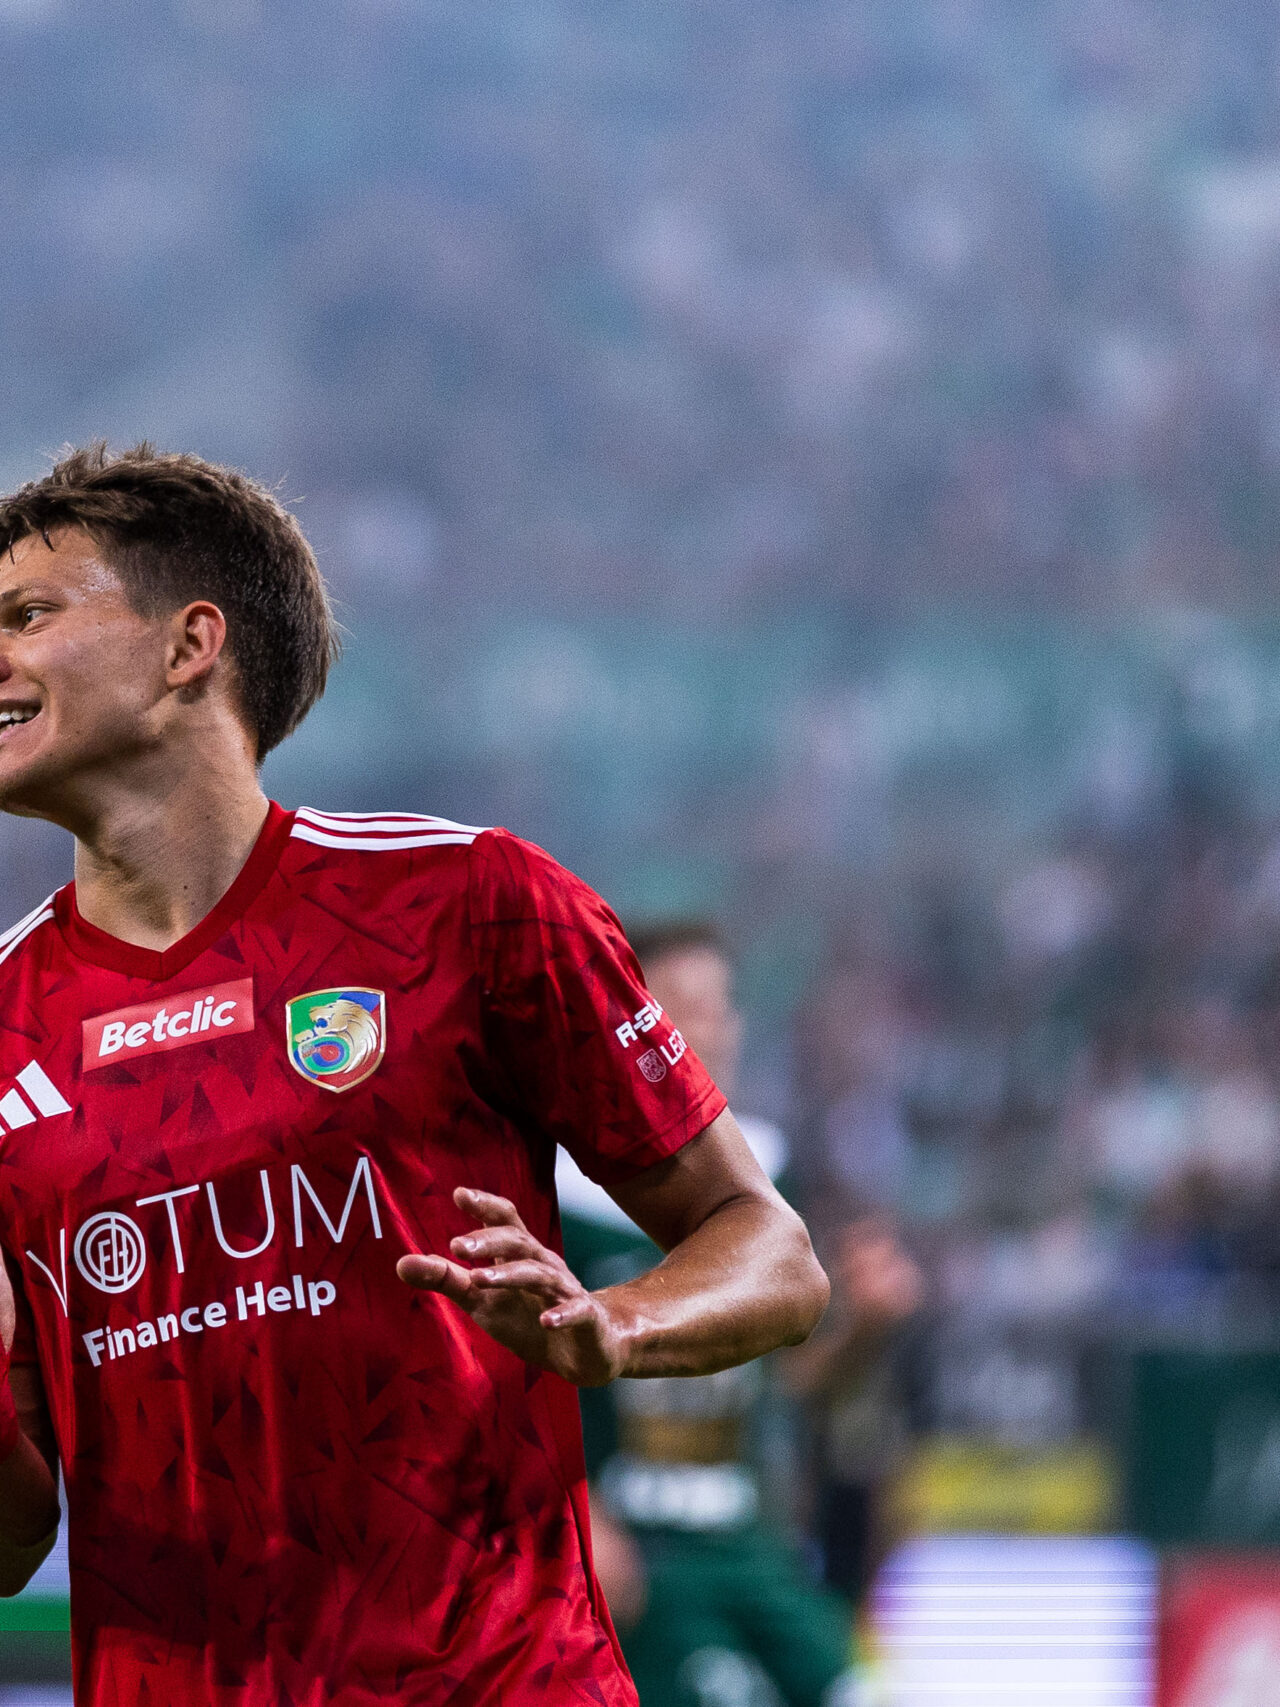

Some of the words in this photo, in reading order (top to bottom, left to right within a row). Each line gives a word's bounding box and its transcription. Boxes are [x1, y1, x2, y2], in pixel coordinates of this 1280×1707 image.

[97, 995, 238, 1058] Betclic
[25, 1156, 384, 1319] VOTUM
[82, 1301, 228, 1368] Finance
[235, 1274, 337, 1317] Help
